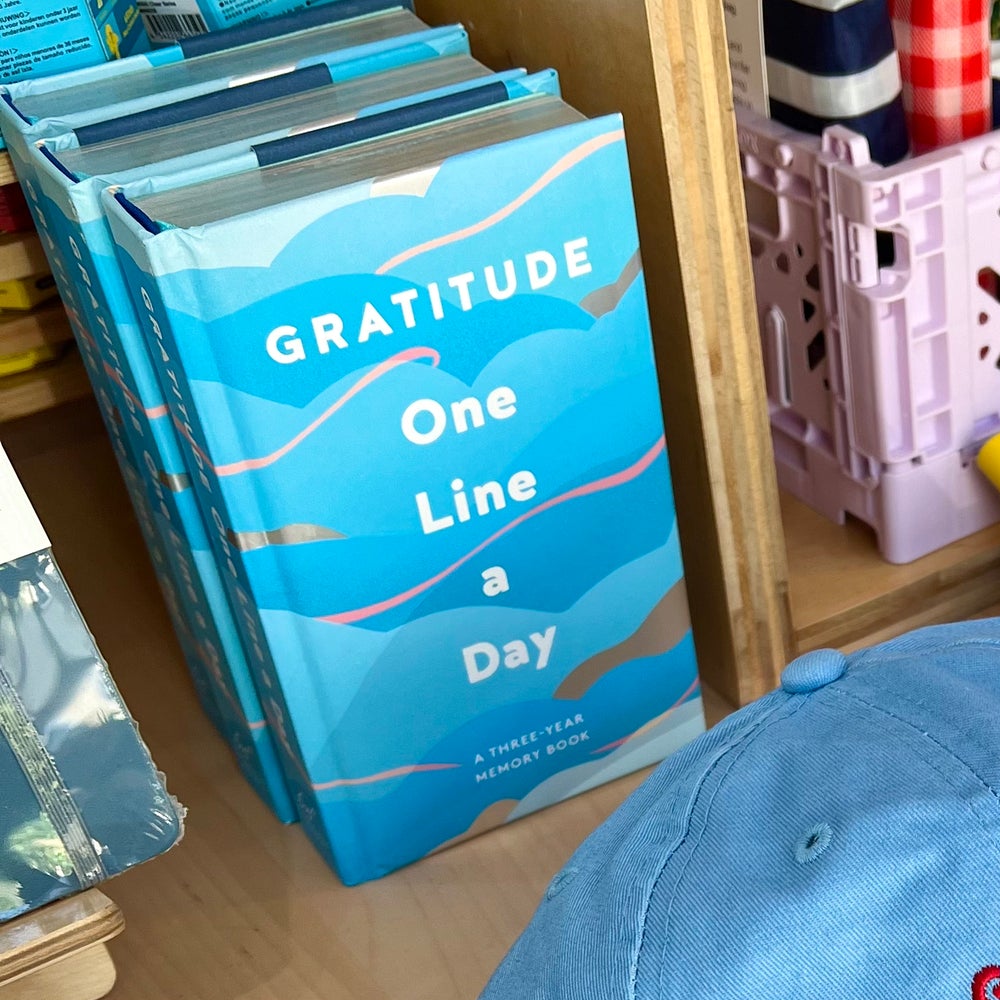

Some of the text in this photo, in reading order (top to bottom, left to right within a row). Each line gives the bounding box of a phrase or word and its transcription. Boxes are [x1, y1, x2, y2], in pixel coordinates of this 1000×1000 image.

[266, 237, 592, 364] GRATITUDE
[140, 286, 213, 494] GRATITUDE
[211, 506, 238, 578] One
[401, 386, 517, 445] One
[415, 470, 537, 534] Line
[482, 565, 509, 597] a
[462, 625, 557, 685] Day
[475, 713, 585, 765] A THREE-YEAR
[475, 730, 590, 784] MEMORY BOOK
